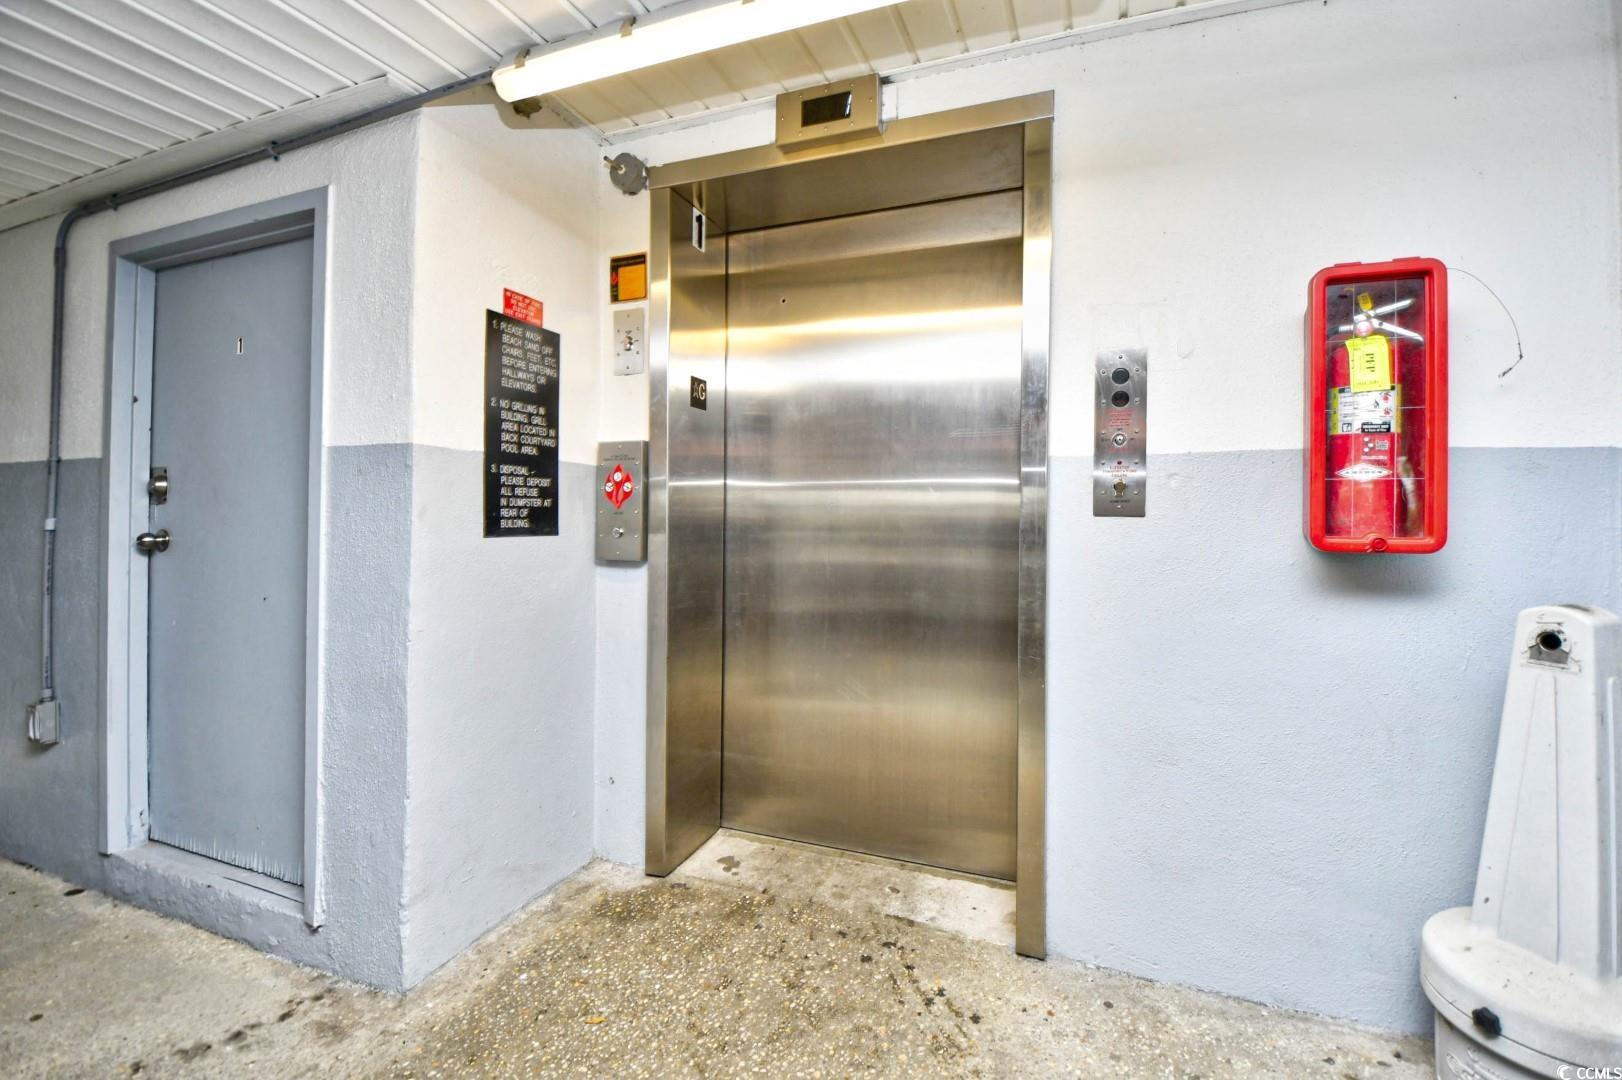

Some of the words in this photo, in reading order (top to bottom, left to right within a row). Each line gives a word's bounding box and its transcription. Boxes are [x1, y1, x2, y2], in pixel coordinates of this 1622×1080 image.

[695, 214, 703, 249] 1
[500, 321, 523, 337] PLEASE
[525, 329, 541, 342] WASH
[502, 333, 522, 347] BEACH
[524, 340, 540, 353] SAND
[541, 346, 553, 355] OFF
[502, 355, 527, 370] BEFORE
[528, 362, 557, 378] ENTERING
[502, 366, 535, 382] HALLWAYS
[536, 375, 546, 385] OR
[699, 383, 706, 400] G
[500, 399, 510, 409] NO
[511, 401, 538, 414] GRILLING
[539, 406, 546, 415] IN
[530, 415, 547, 426] GRILL
[501, 421, 519, 432] AREA
[520, 424, 547, 436] LOCATED
[548, 428, 556, 437] IN
[501, 432, 519, 443] BACK
[520, 435, 556, 448] COURTYARD
[500, 443, 519, 454] POOL
[500, 464, 529, 475] DISPOSAL
[500, 475, 525, 486] PLEASE
[526, 478, 552, 488] DEPOSIT
[500, 486, 513, 496] ALL
[514, 487, 539, 497] REFUSE
[500, 497, 508, 507] IN
[509, 498, 542, 508] DUMPSTER
[543, 498, 552, 508] AT
[500, 508, 518, 518] REAR
[519, 508, 529, 518] OF
